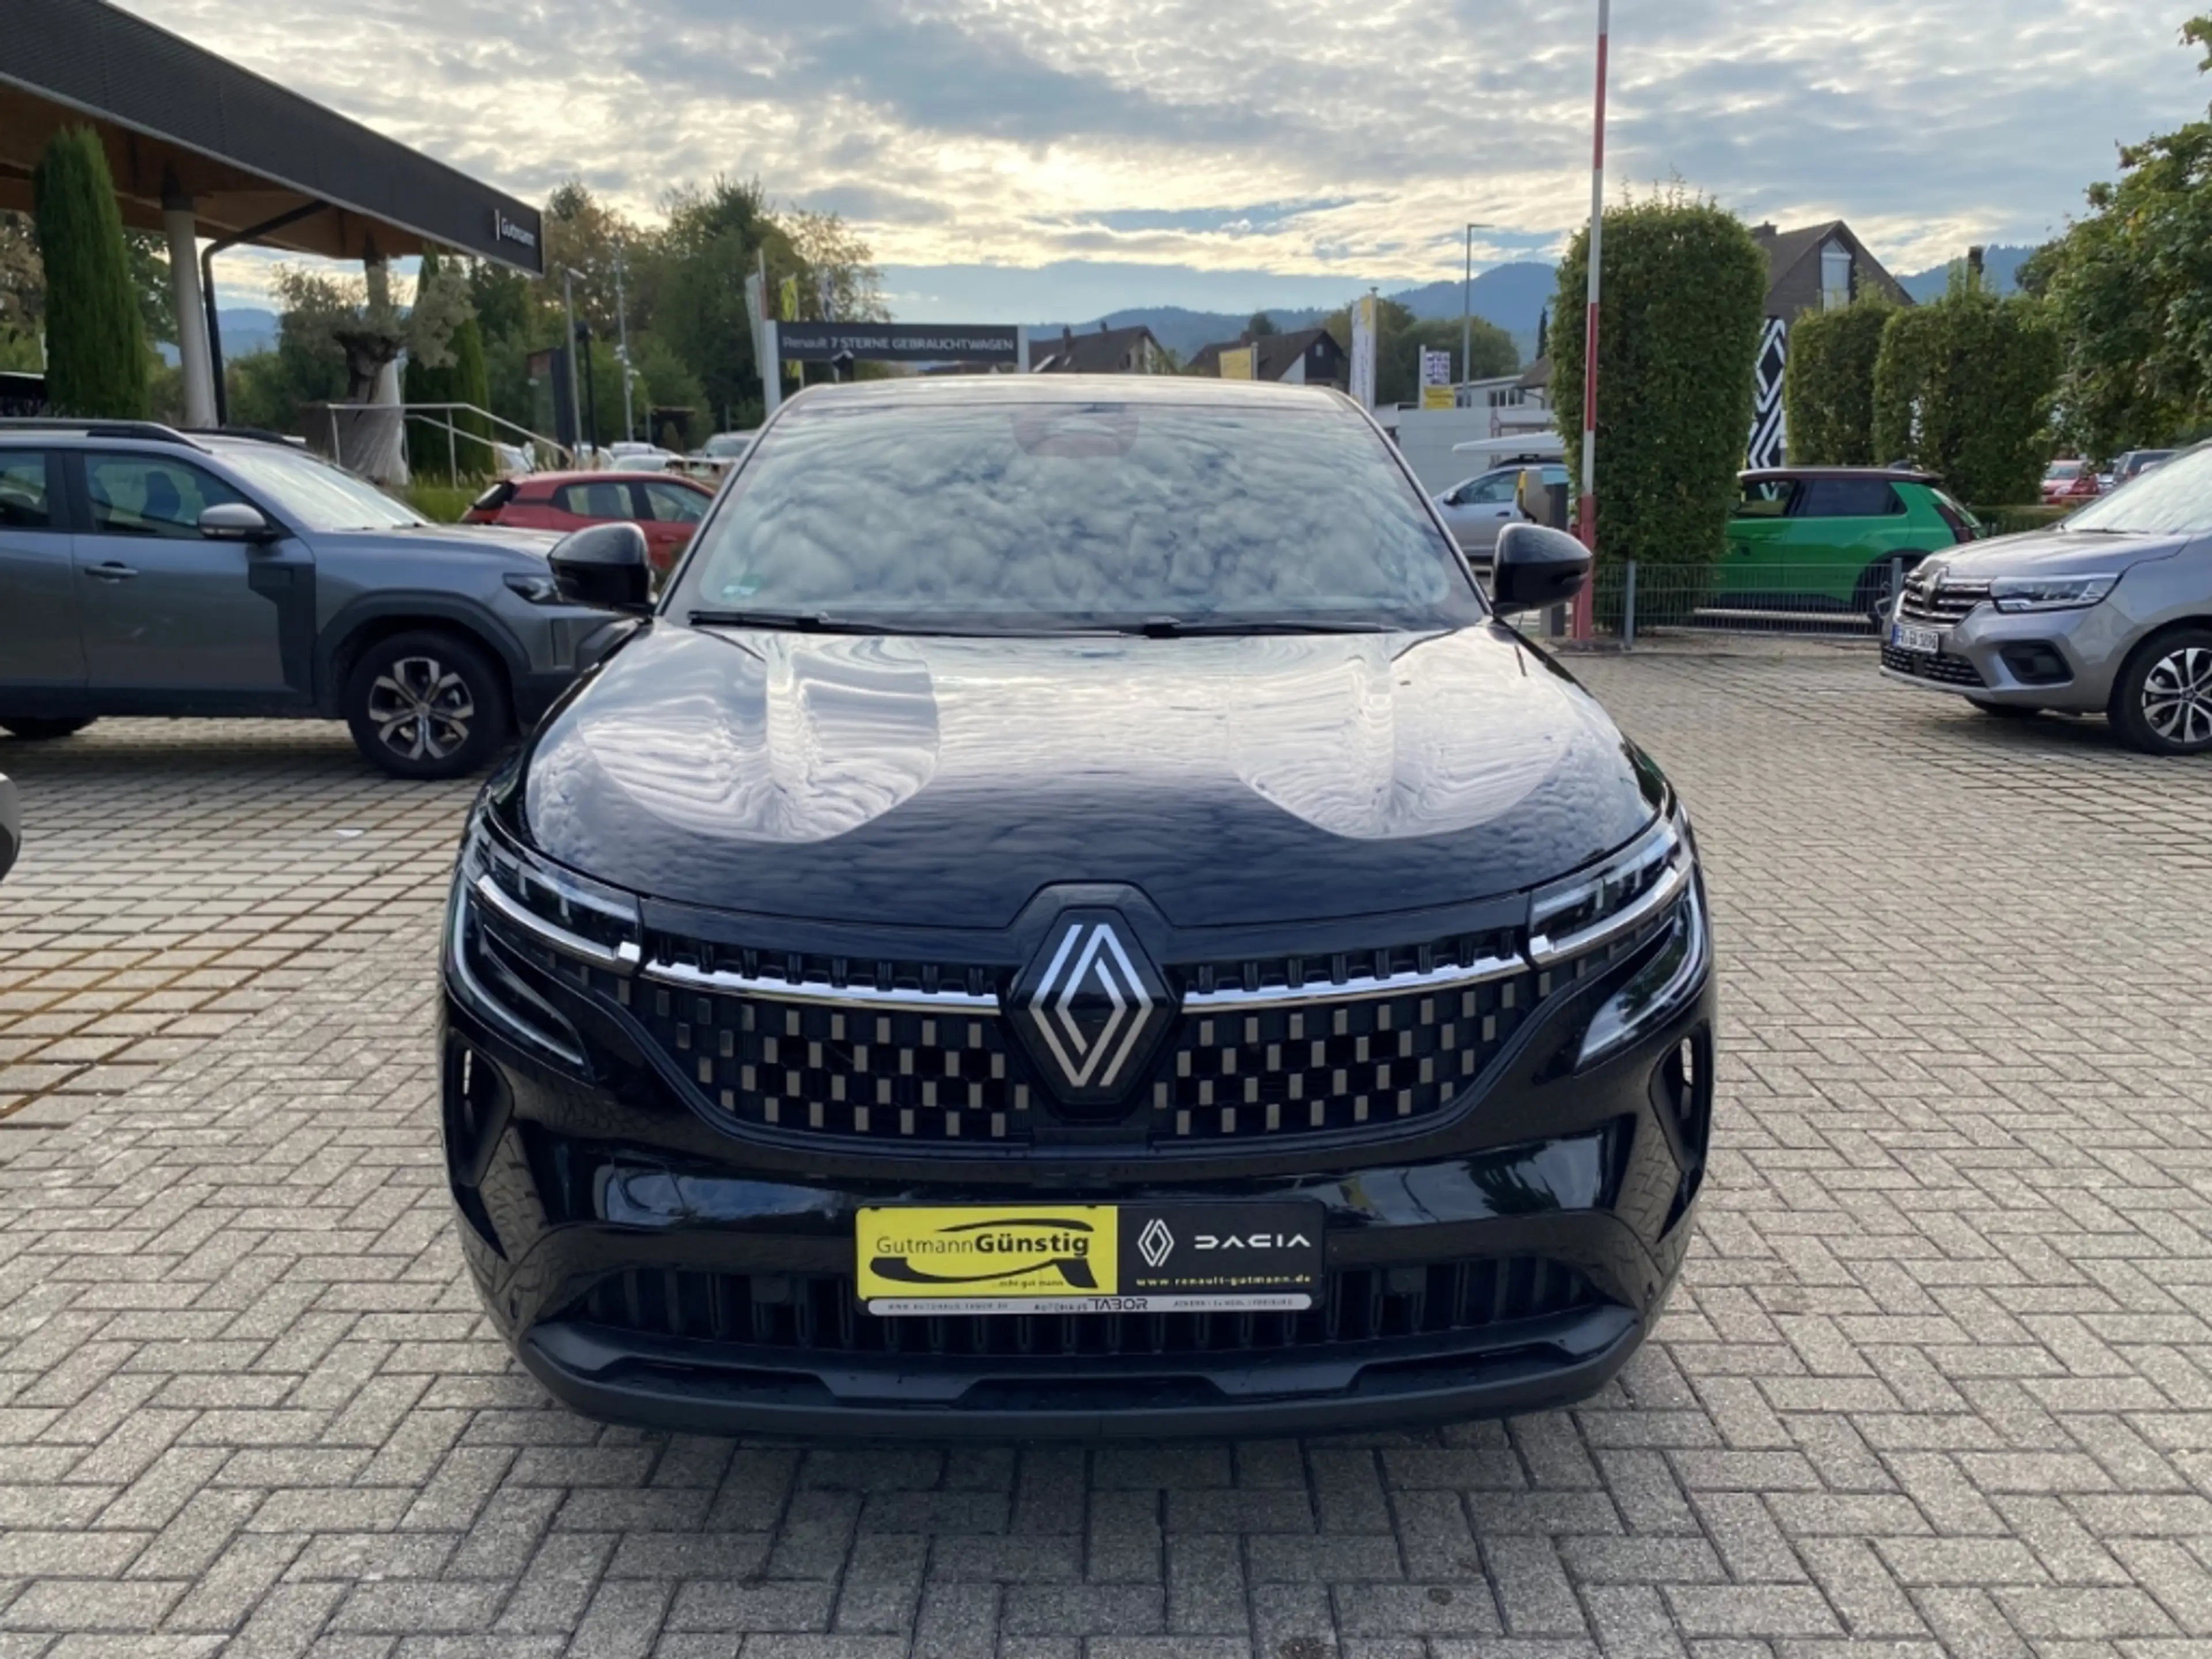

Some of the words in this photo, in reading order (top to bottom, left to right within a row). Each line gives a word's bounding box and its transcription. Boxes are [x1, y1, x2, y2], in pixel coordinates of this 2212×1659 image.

[782, 336, 827, 349] Renault
[831, 336, 838, 349] 7
[840, 336, 889, 350] STERNE
[892, 337, 1014, 350] GEBRAUCHTWAGEN
[1194, 1233, 1312, 1249] DACIA
[1136, 1274, 1311, 1287] www.renault-gutmann.de
[1088, 1298, 1148, 1310] TABOR
